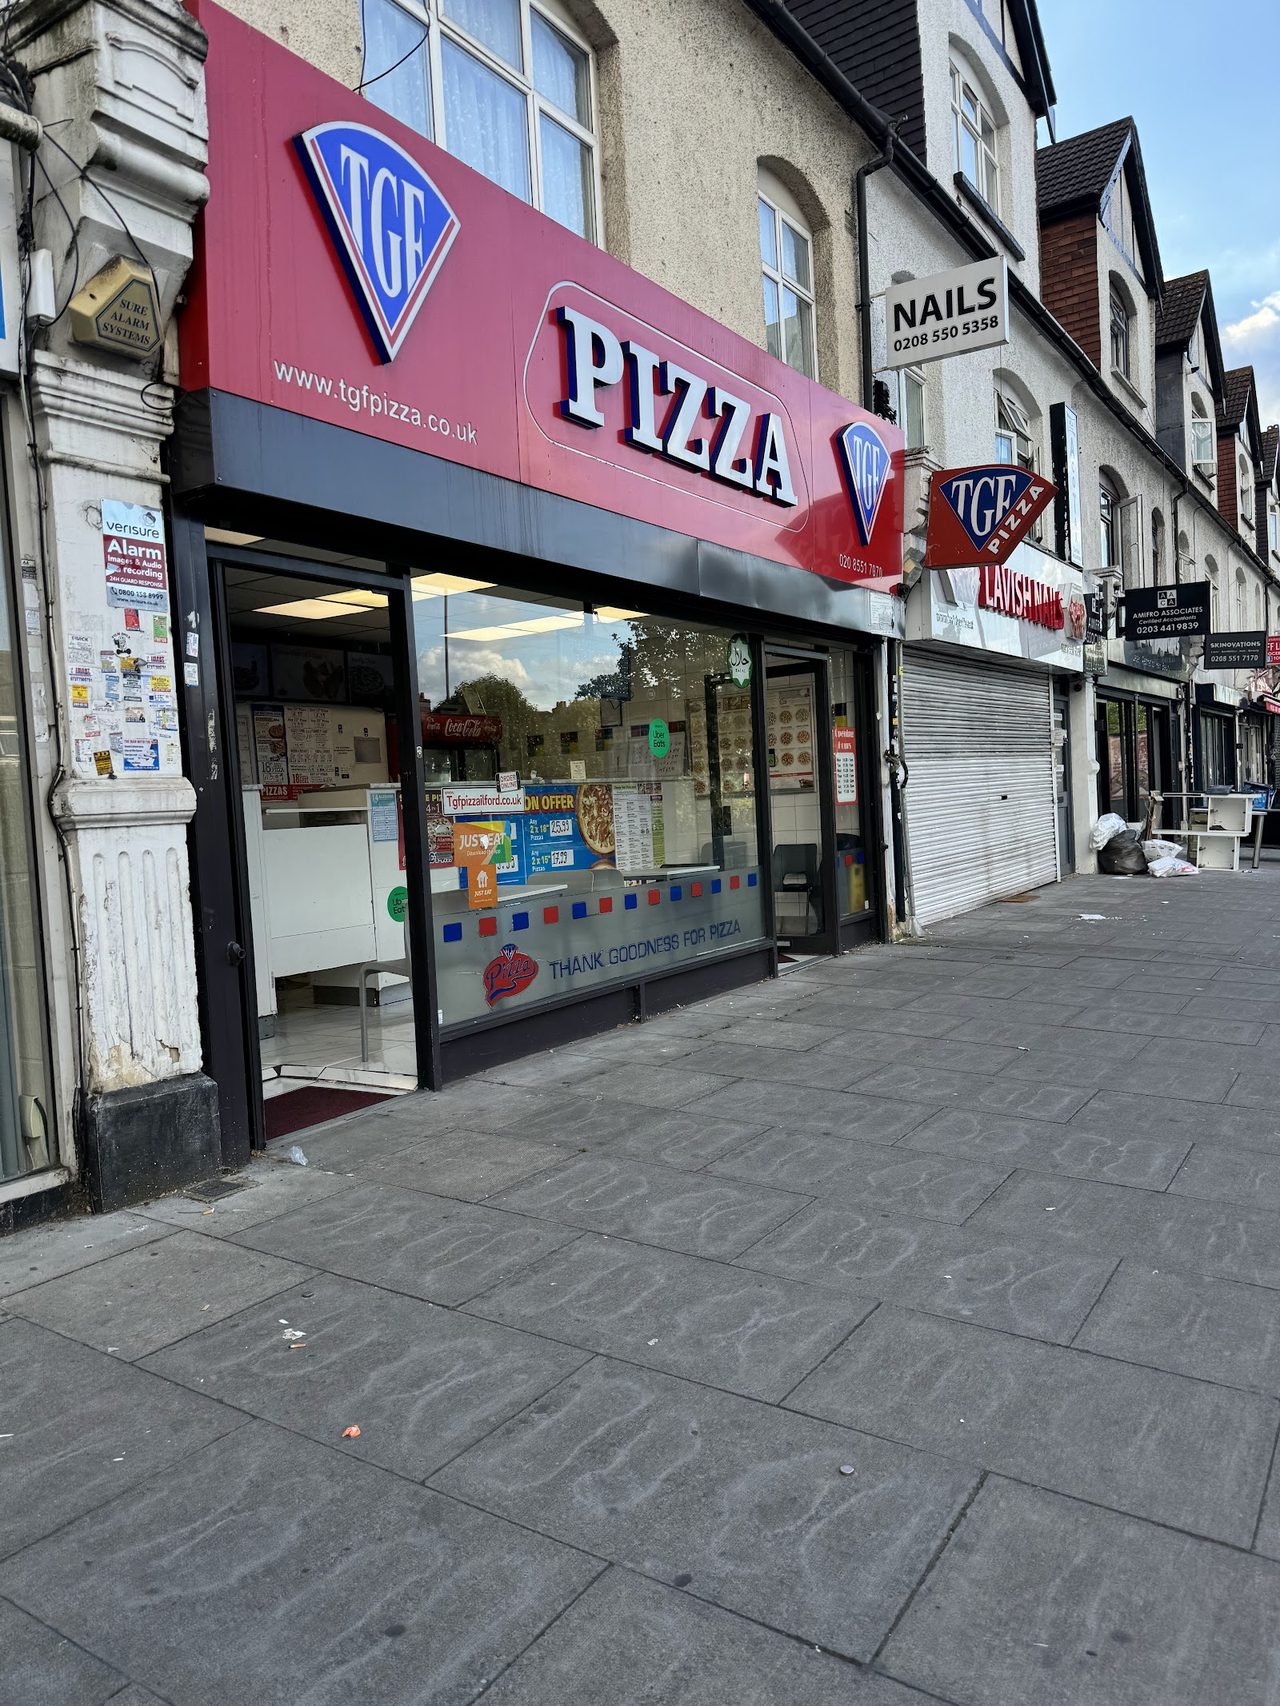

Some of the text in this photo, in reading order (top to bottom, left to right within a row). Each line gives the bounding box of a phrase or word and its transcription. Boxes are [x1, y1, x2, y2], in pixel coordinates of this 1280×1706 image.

[340, 143, 426, 298] TGF
[120, 299, 148, 317] SURE
[893, 278, 997, 332] NAILS
[111, 311, 150, 332] ALARM
[102, 322, 151, 345] SYSTEMS
[893, 315, 999, 352] 0208 550 5358
[273, 360, 479, 446] www.tgfpizza.co.uk
[560, 305, 798, 506] PIZZA
[853, 434, 881, 510] TGF
[951, 474, 1017, 537] TGF
[106, 520, 160, 539] verisure
[987, 485, 1045, 555] PIZZA
[107, 538, 162, 560] Alarm
[107, 554, 133, 565] Images
[142, 559, 162, 569] Audio
[839, 553, 851, 570] 020
[852, 558, 868, 575] 8551
[123, 566, 163, 581] recording
[118, 588, 135, 597] 0800
[984, 566, 1032, 616] LAVISH
[1160, 606, 1203, 617] ASSOCIATES
[1136, 621, 1199, 634] 0203 441 9839
[1210, 640, 1261, 649] SKINOVATIONS
[653, 739, 666, 748] Eats
[260, 785, 288, 797] PIZZAS
[446, 794, 522, 810] Tgfpizzailford.co.uk
[541, 794, 574, 810] OFFER
[529, 826, 534, 834] 2
[531, 857, 536, 865] 2
[393, 906, 406, 914] Eat
[548, 918, 741, 980] THANK GOODNESS FOR PIZZA
